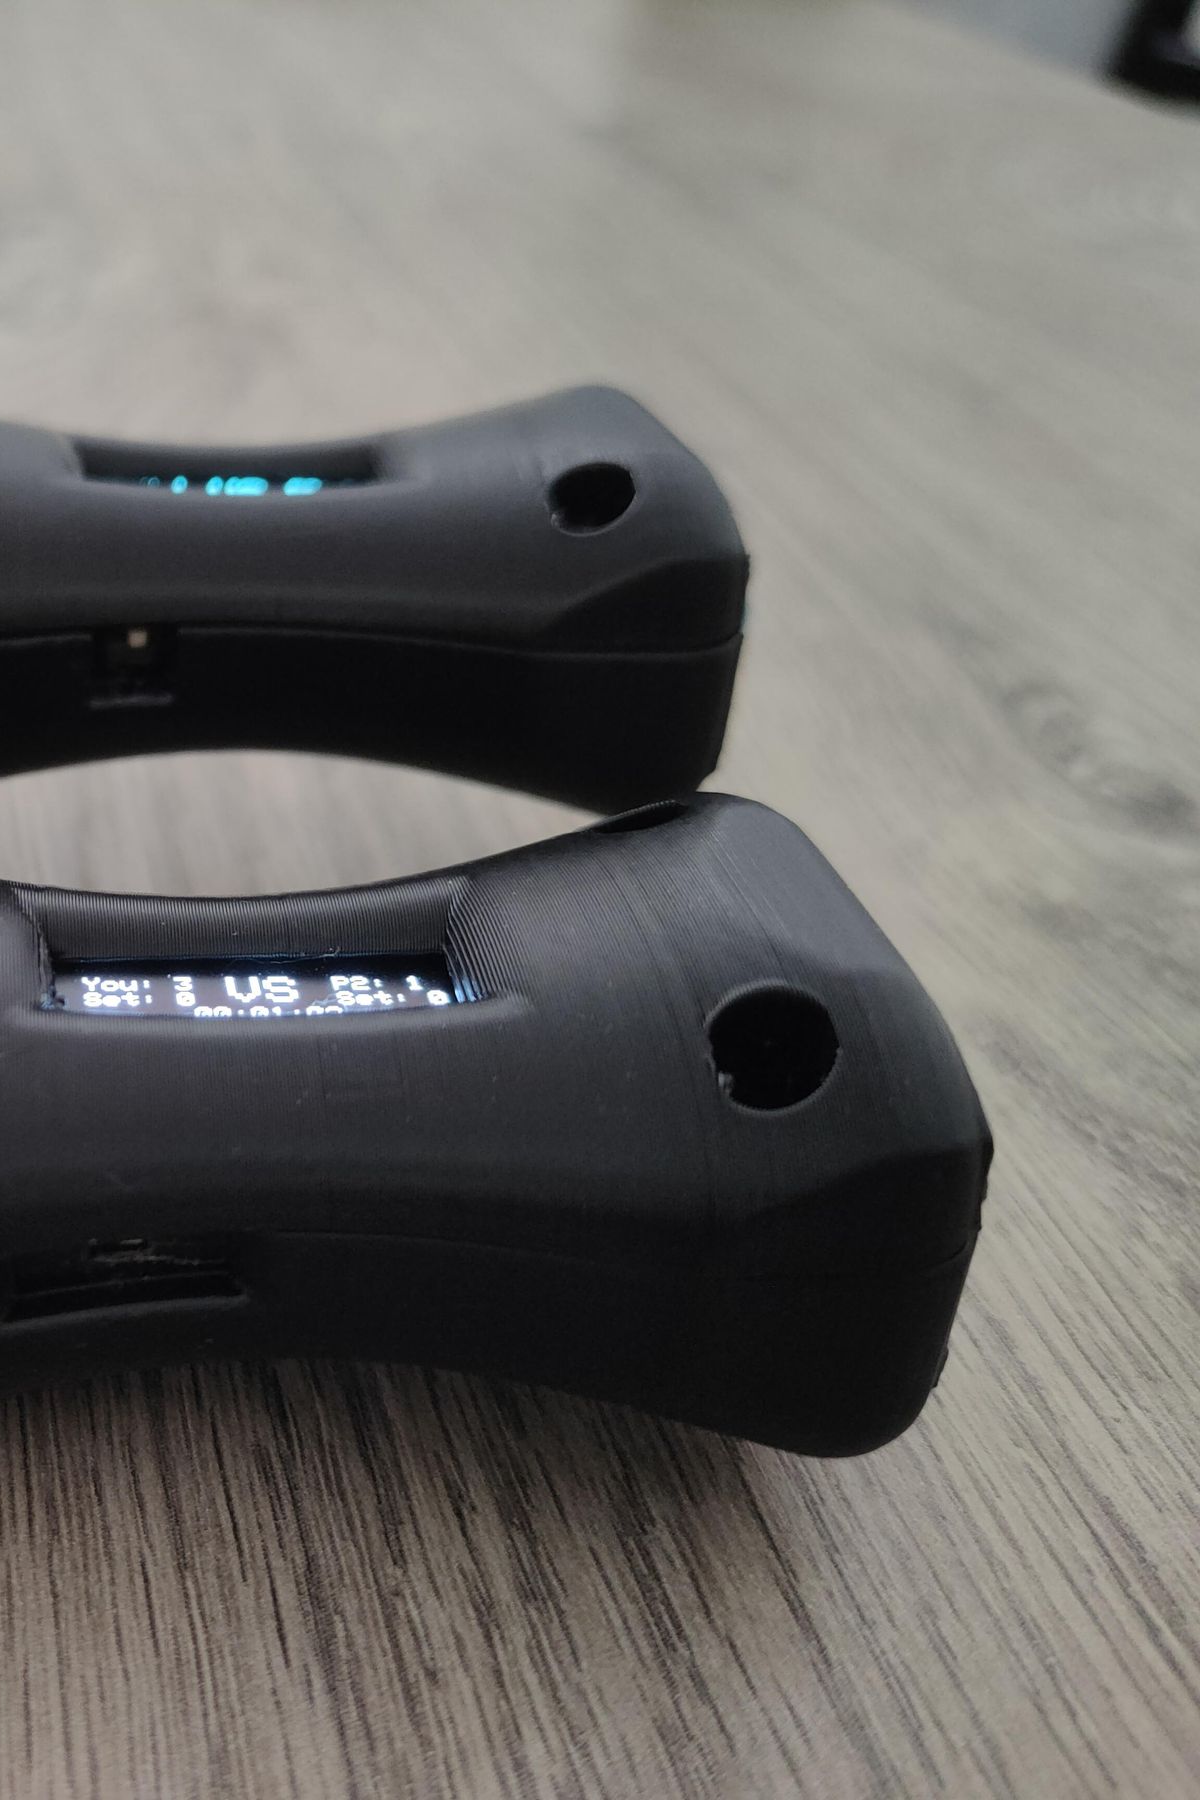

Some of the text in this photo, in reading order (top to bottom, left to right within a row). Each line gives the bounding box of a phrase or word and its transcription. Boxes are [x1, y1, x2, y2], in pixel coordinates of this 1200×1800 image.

[81, 976, 194, 992] You: 3
[224, 976, 299, 1003] VS
[330, 975, 423, 991] P2: 1
[82, 991, 152, 1007] Set:
[335, 990, 405, 1006] Set:
